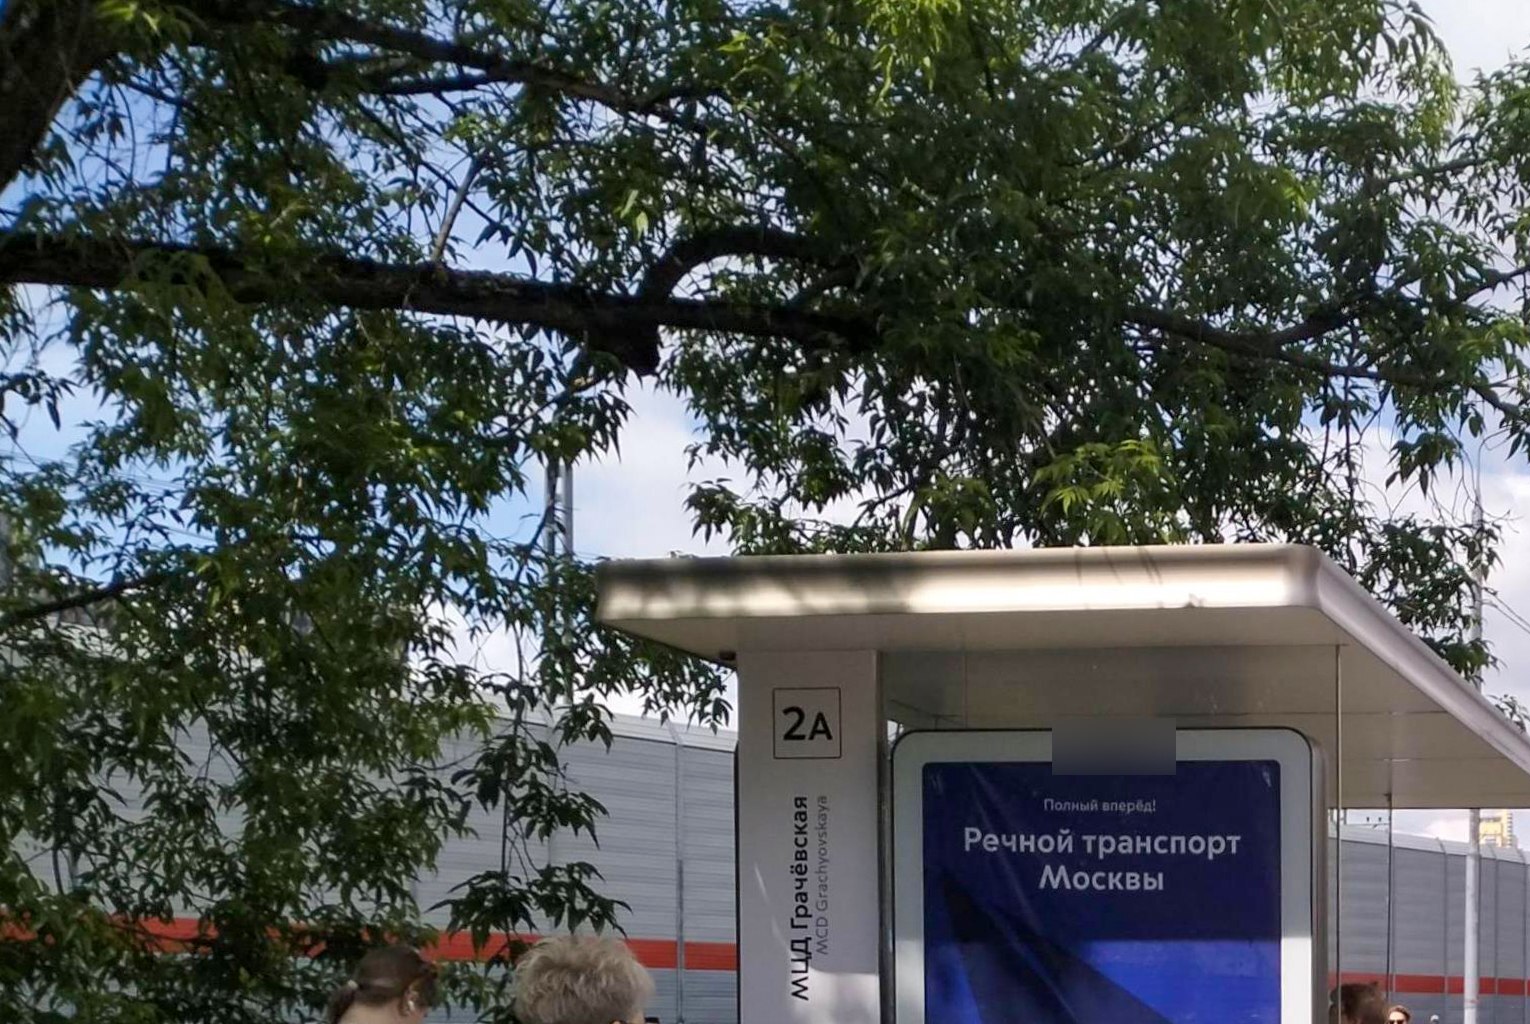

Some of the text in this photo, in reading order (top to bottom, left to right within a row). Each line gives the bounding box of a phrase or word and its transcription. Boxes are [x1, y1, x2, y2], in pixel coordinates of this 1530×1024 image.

[1043, 799, 1156, 814] Полный вперёд!
[964, 826, 1241, 860] Речной транспорт
[815, 796, 829, 955] MCD Grachyovskaya
[1038, 864, 1164, 891] Москвы
[790, 796, 812, 1001] МЦД Грачёвская
